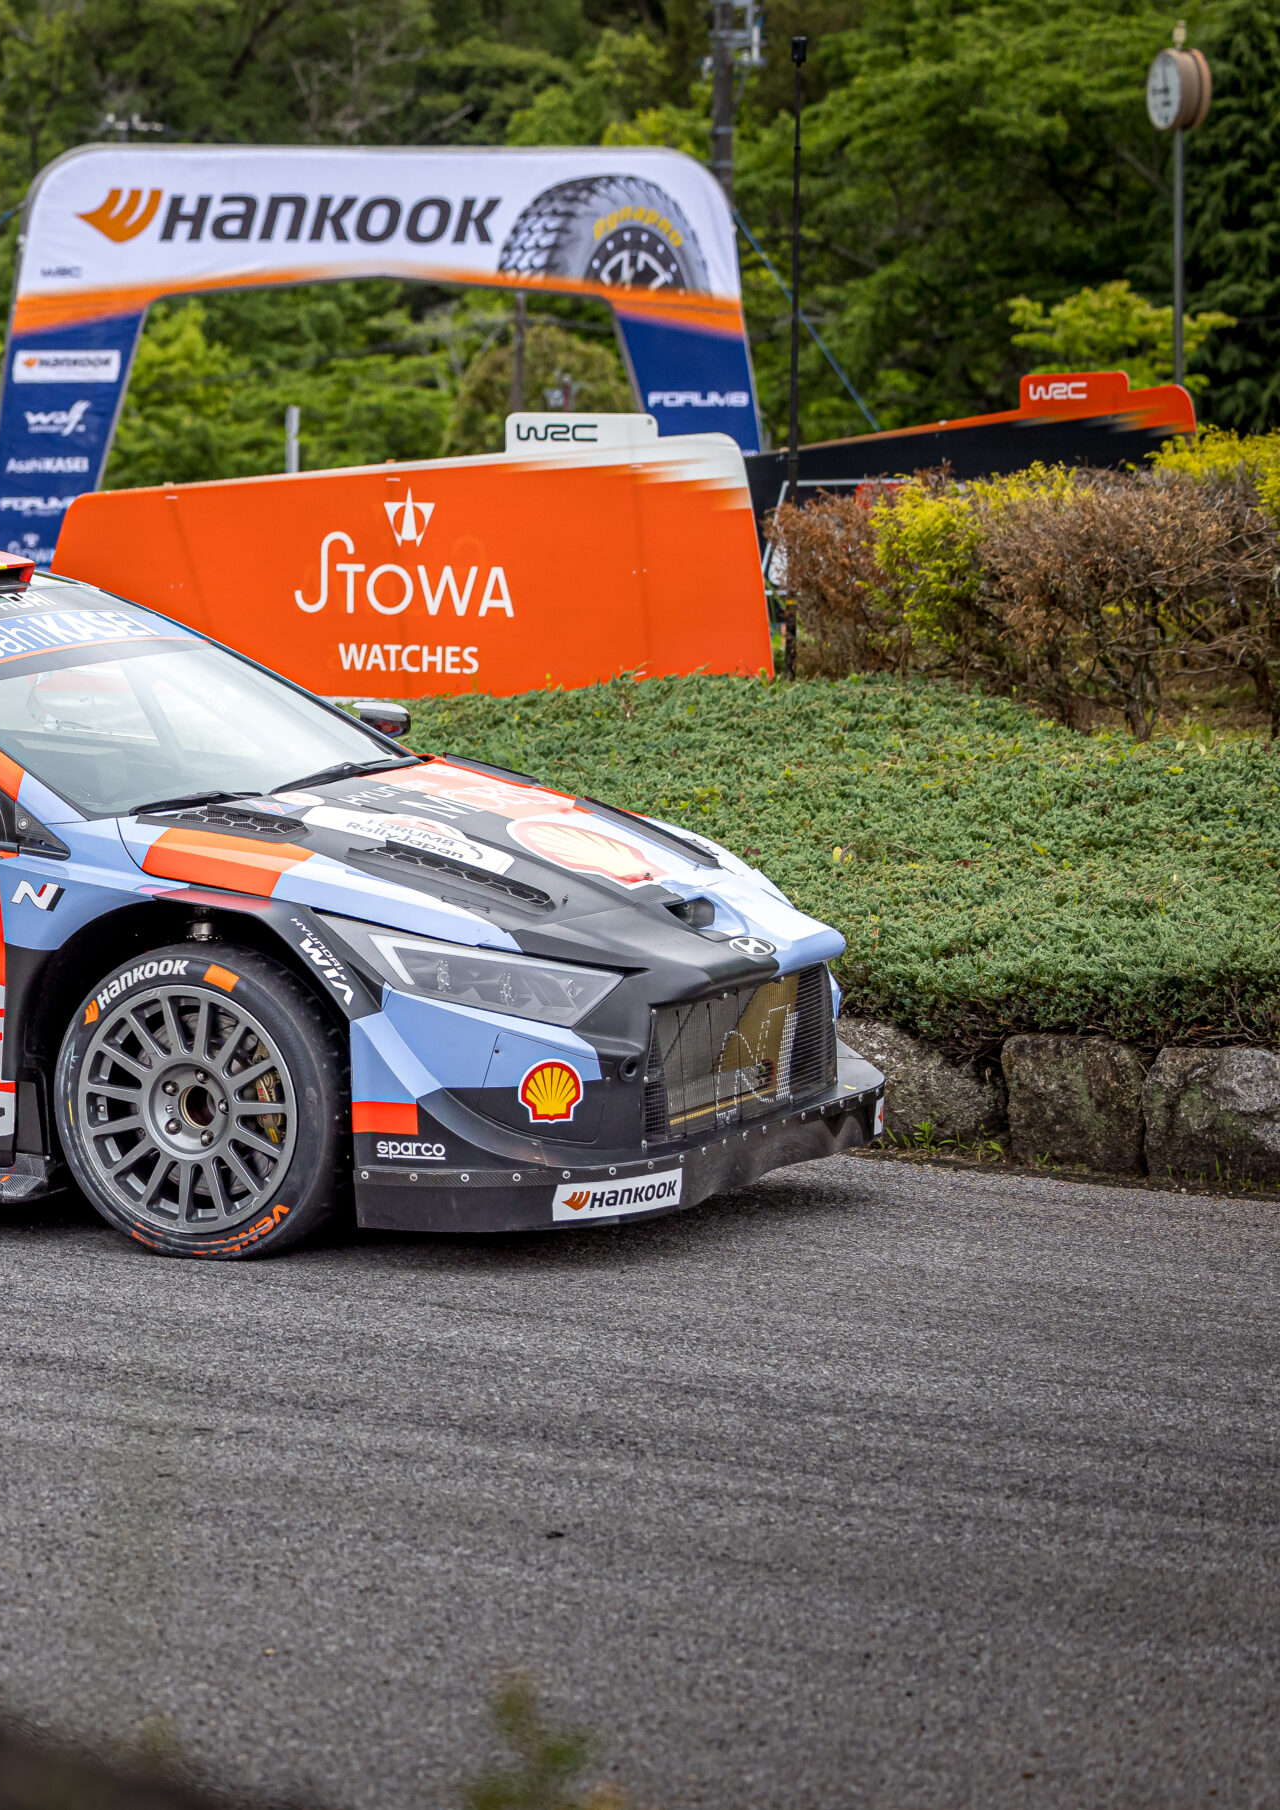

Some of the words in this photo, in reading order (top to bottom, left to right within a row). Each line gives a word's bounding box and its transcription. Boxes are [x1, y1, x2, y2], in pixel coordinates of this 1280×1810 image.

[647, 391, 750, 408] FORUM8
[1028, 381, 1089, 401] WRC
[516, 423, 598, 443] WRC
[294, 530, 515, 619] STOWA
[337, 642, 480, 675] WATCHES
[289, 917, 345, 972] HYUNDAI
[299, 937, 354, 1006] WIA
[376, 1140, 447, 1160] sparco
